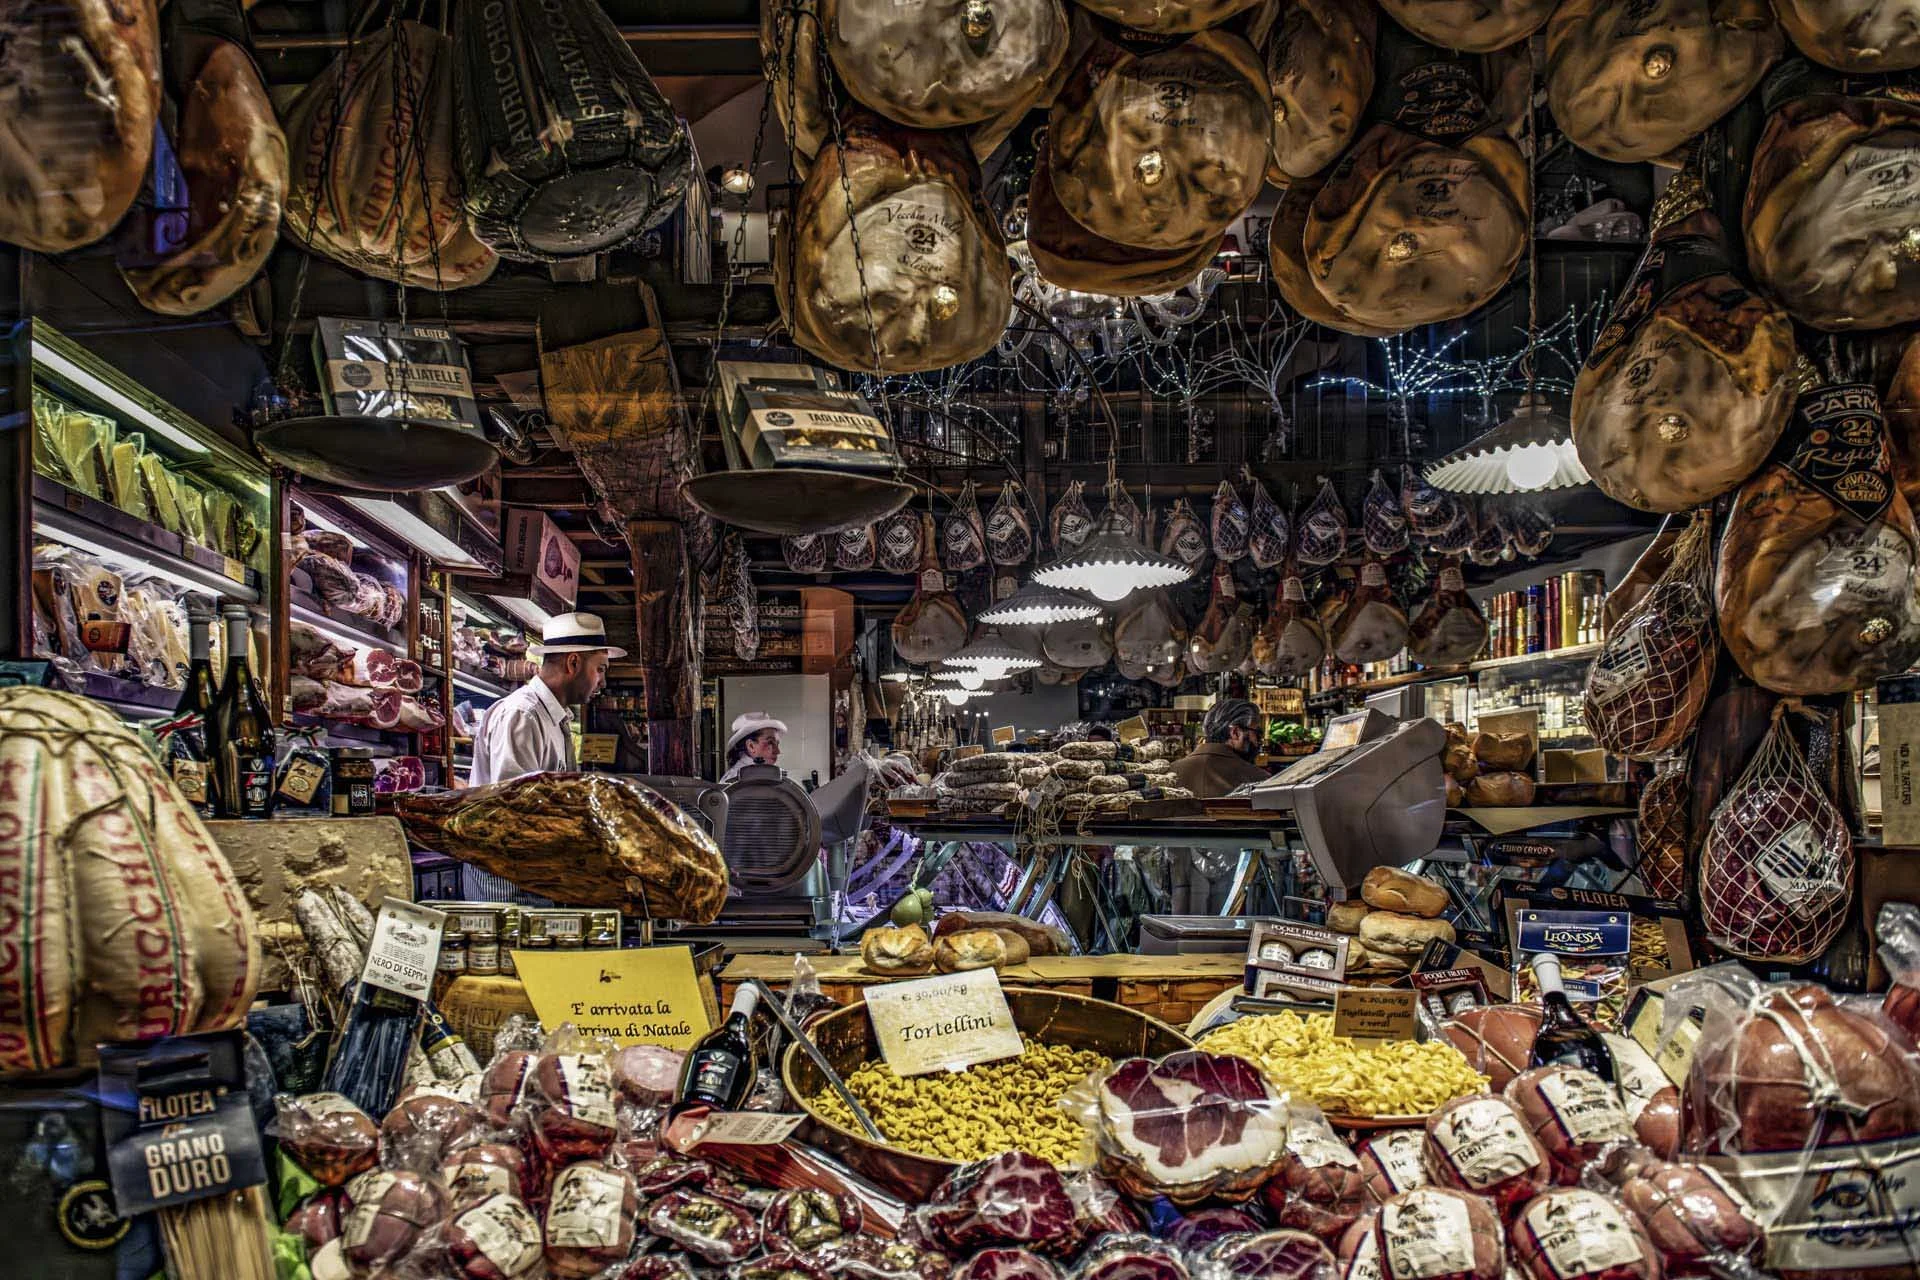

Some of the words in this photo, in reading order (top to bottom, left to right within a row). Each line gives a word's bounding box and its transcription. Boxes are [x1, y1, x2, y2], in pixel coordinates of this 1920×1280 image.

[1161, 83, 1190, 101] 24
[1878, 164, 1912, 186] 24
[1422, 182, 1449, 197] 24
[911, 229, 938, 248] 24
[413, 327, 450, 340] FILOTEA
[1842, 419, 1874, 438] 24
[1853, 555, 1882, 572] 24
[1572, 889, 1630, 909] FILOTEA
[98, 806, 176, 1040] URICCHIO
[1271, 923, 1299, 933] POCKET
[1302, 928, 1332, 939] TRUFFLE
[1544, 929, 1604, 944] LEONESSA
[371, 955, 393, 971] NERO
[394, 962, 402, 973] DI
[403, 966, 428, 982] SEPPIA
[1424, 972, 1448, 982] POCKET
[1449, 969, 1471, 979] TRUFFLE
[1276, 973, 1305, 984] POCKET
[590, 1002, 654, 1016] arrivata
[656, 999, 672, 1015] la
[625, 1022, 641, 1037] di
[643, 1020, 692, 1037] Natale
[900, 1012, 996, 1042] Tortellini
[139, 1089, 216, 1122] FILOTEA
[145, 1133, 225, 1168] GRANO
[149, 1154, 232, 1200] DURO
